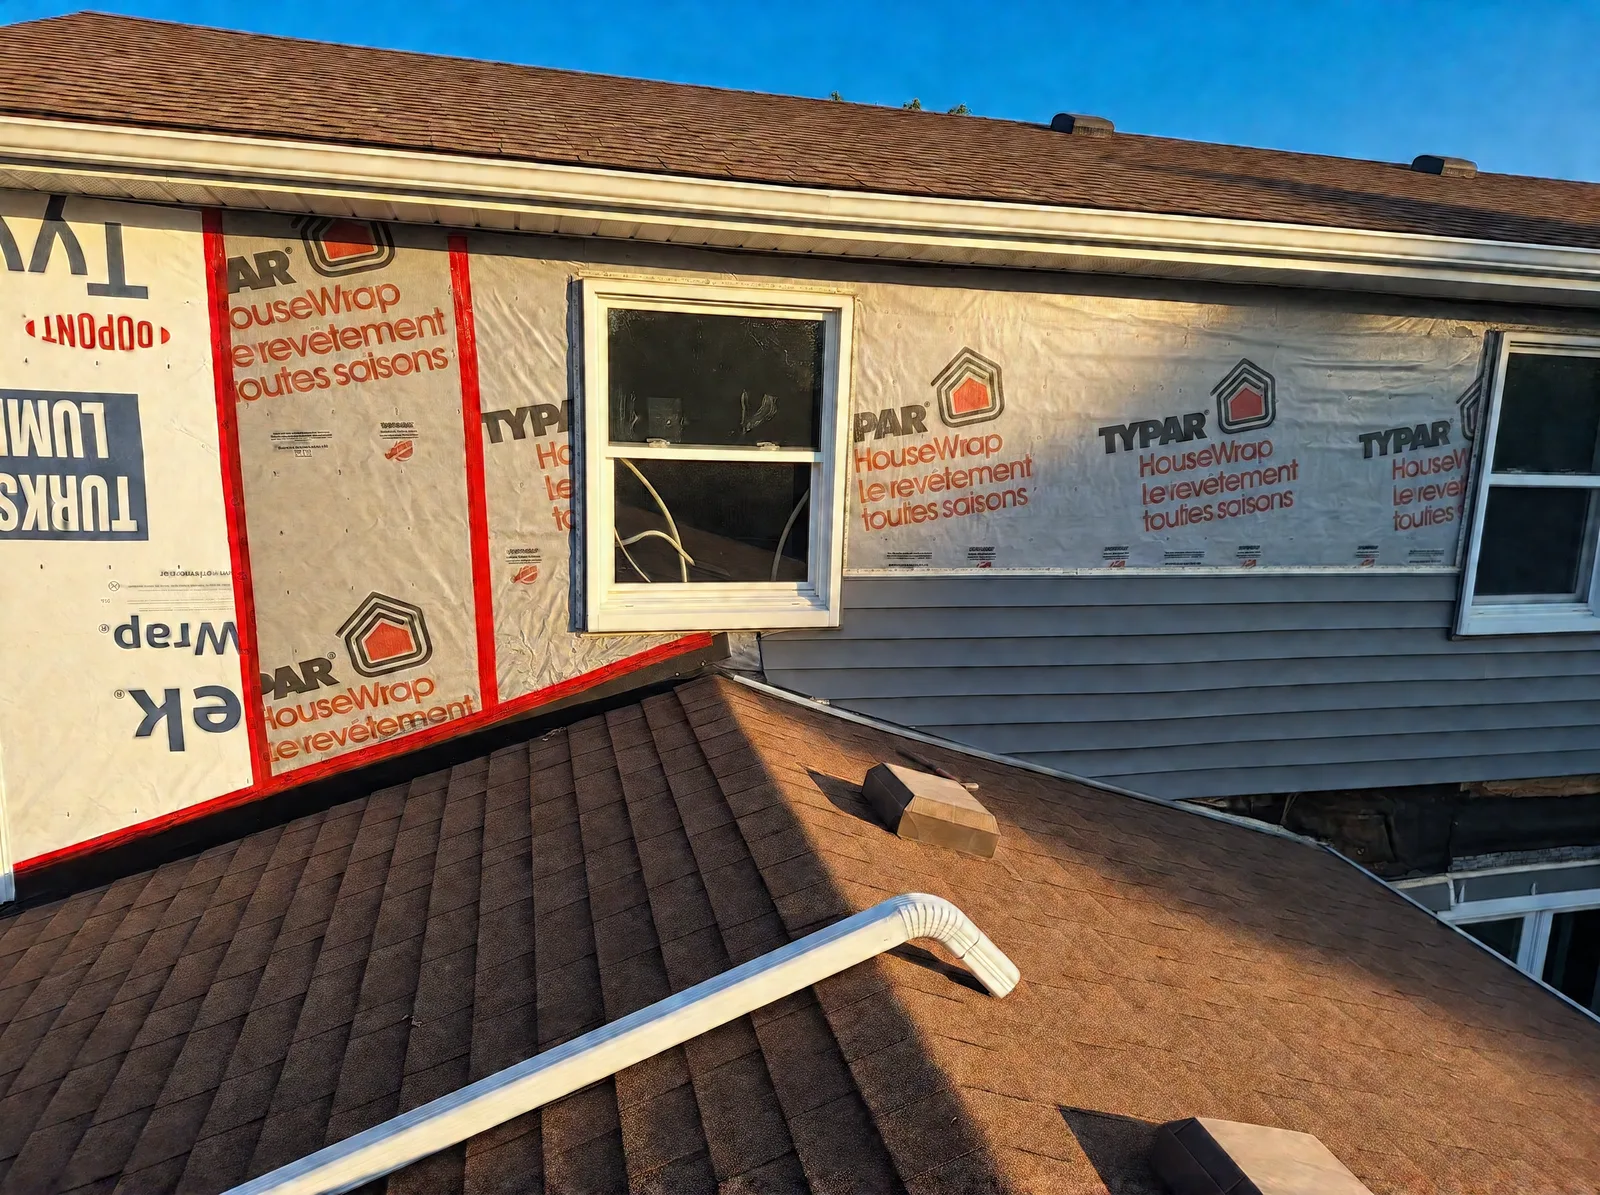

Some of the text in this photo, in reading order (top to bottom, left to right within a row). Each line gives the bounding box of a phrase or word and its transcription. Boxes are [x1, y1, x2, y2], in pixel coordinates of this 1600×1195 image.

[42, 312, 154, 351] DUPONT
[333, 347, 449, 386] saisons
[0, 397, 110, 459] LUM
[853, 403, 928, 443] PAR
[1098, 412, 1208, 454] TYPAR
[1358, 420, 1451, 459] TYPAR
[855, 433, 1003, 473] HouseWrap
[1139, 439, 1274, 478] HouseWrap
[857, 479, 887, 504] Le
[942, 486, 1029, 519] saisons
[1142, 483, 1167, 505] Le
[1217, 490, 1294, 519] saisons
[1393, 485, 1414, 507] Le
[128, 685, 242, 752] ek
